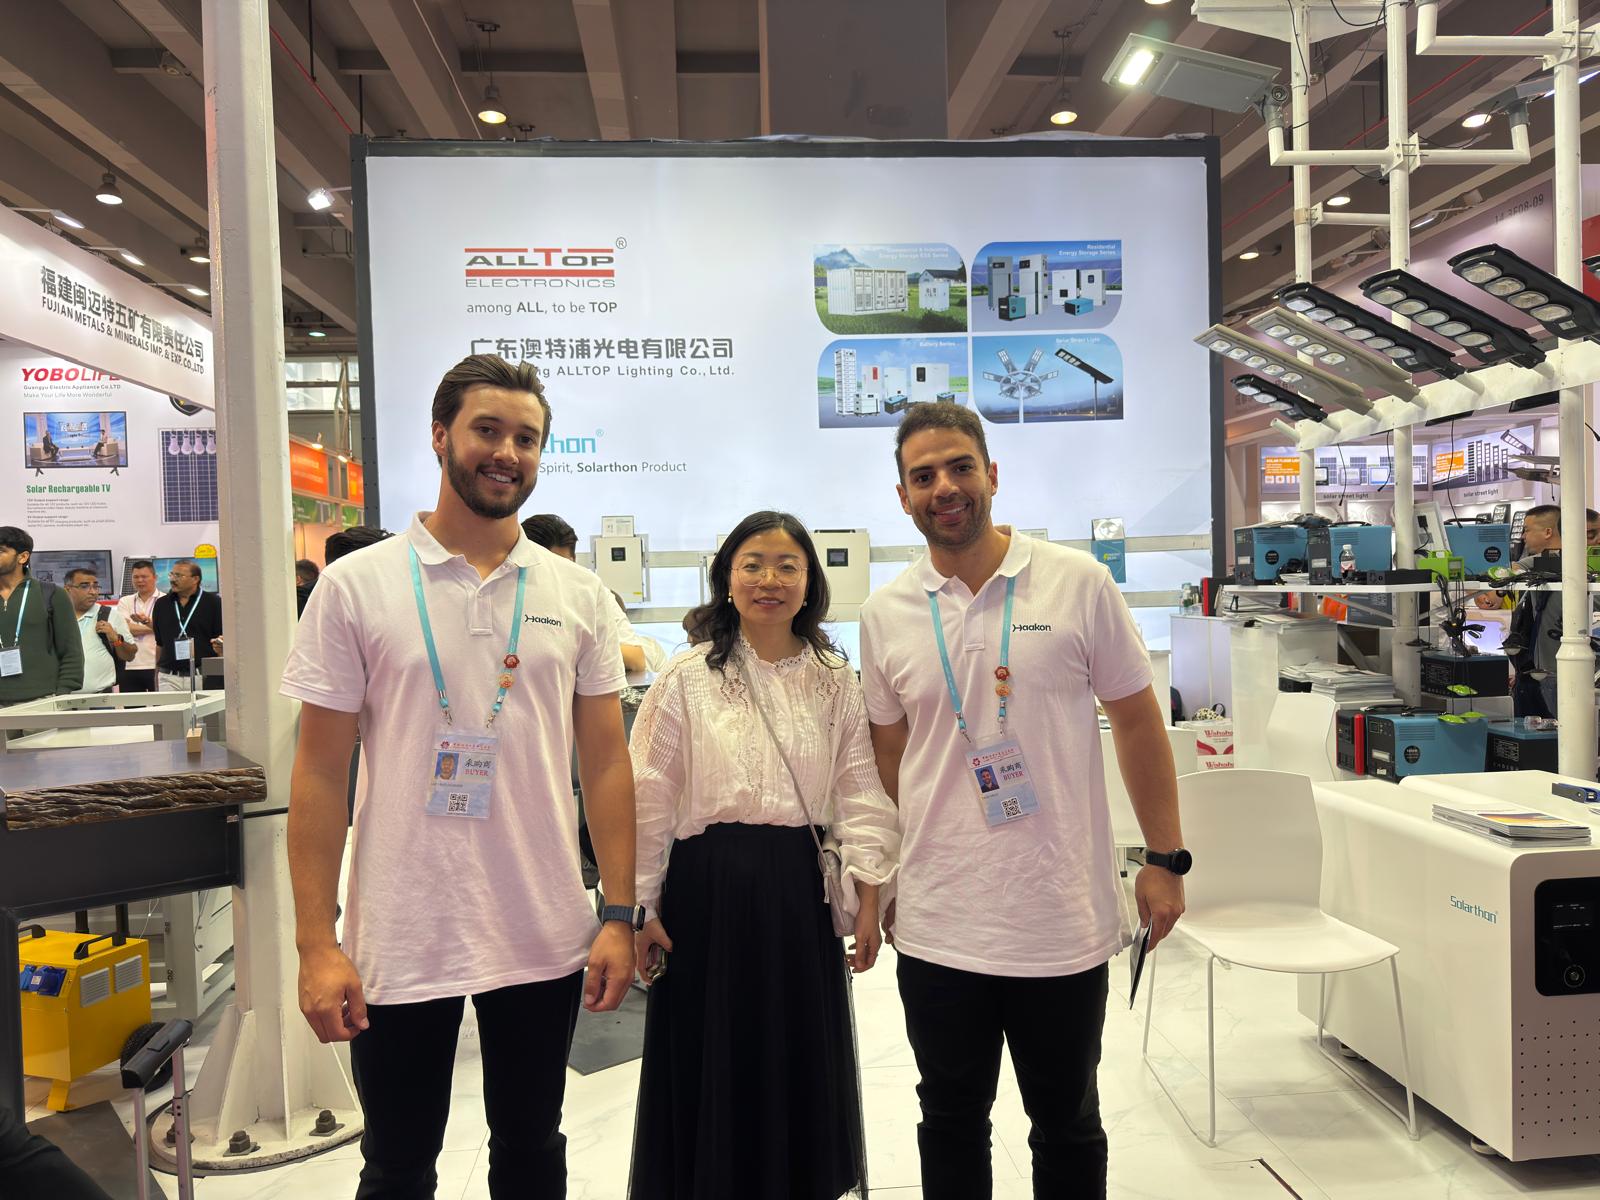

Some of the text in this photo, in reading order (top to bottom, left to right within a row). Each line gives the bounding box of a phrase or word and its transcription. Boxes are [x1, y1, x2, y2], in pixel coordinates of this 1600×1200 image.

[466, 248, 614, 266] ALLTOP
[466, 278, 616, 288] ELECTRONICS
[41, 266, 204, 362] 福建闽迈特五矿有限责任公司
[466, 302, 618, 315] among ALL, to be TOP
[42, 296, 73, 322] FUJIAN
[74, 310, 105, 334] METALS
[106, 325, 113, 336] &
[114, 329, 150, 351] MINERALS
[150, 343, 163, 358] IMP.
[164, 349, 170, 360] &
[171, 352, 182, 366] EXP.
[470, 338, 734, 359] 广东澳特浦光电有限公司
[556, 366, 610, 376] ALLTOP
[618, 366, 674, 378] Lighting
[539, 461, 687, 475] Spirit, Solarthon Product
[26, 484, 111, 494] Solar Rechargeable TV
[1003, 771, 1024, 780] BUYER
[1450, 895, 1496, 924] Solarthon
